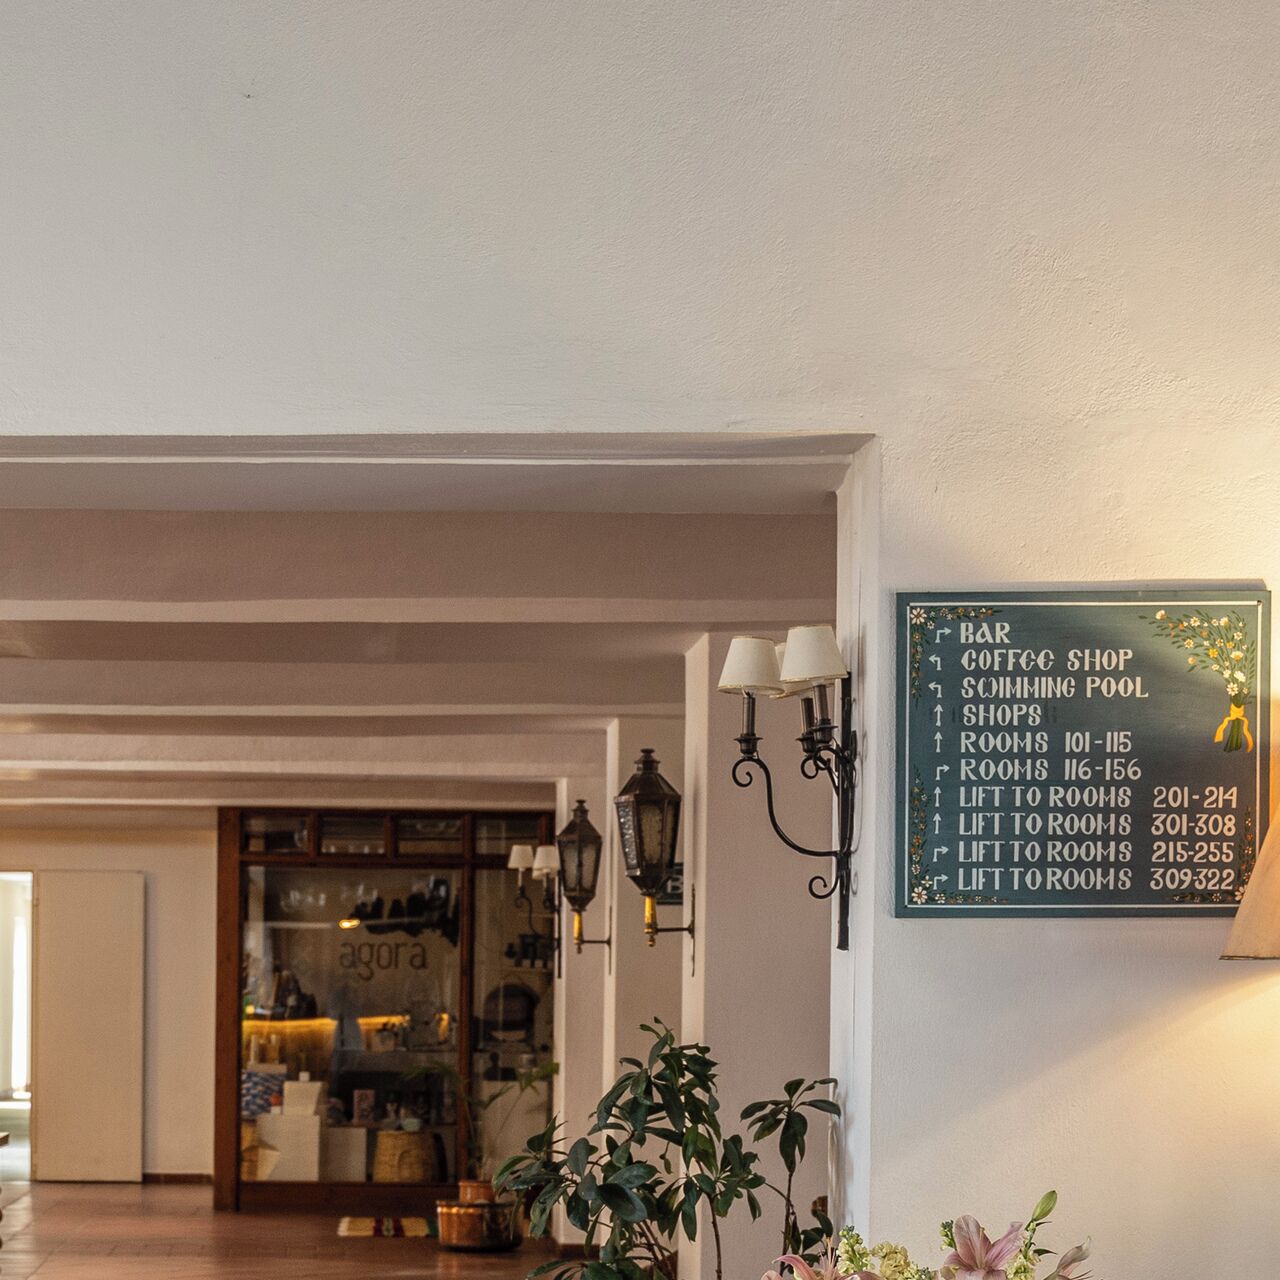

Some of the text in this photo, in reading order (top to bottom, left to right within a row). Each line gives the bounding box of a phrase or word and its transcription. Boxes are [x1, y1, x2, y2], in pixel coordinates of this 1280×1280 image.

[960, 622, 1011, 644] BAR
[960, 648, 1133, 671] COFFEE SHOP
[960, 675, 1149, 699] SWIMMING POOL
[962, 703, 1042, 727] SHOPS
[960, 731, 1132, 753] ROOMS 101-115
[960, 758, 1142, 781] ROOMS 116-156
[958, 786, 1238, 809] LIFT TO ROOMS 201-214
[958, 813, 1236, 836] LIFT TO ROOMS 301-308
[958, 840, 1235, 863] LIFT TO ROOMS 215-255
[958, 868, 1235, 890] LIFT TO ROOMS 309-322
[340, 942, 428, 981] agora
